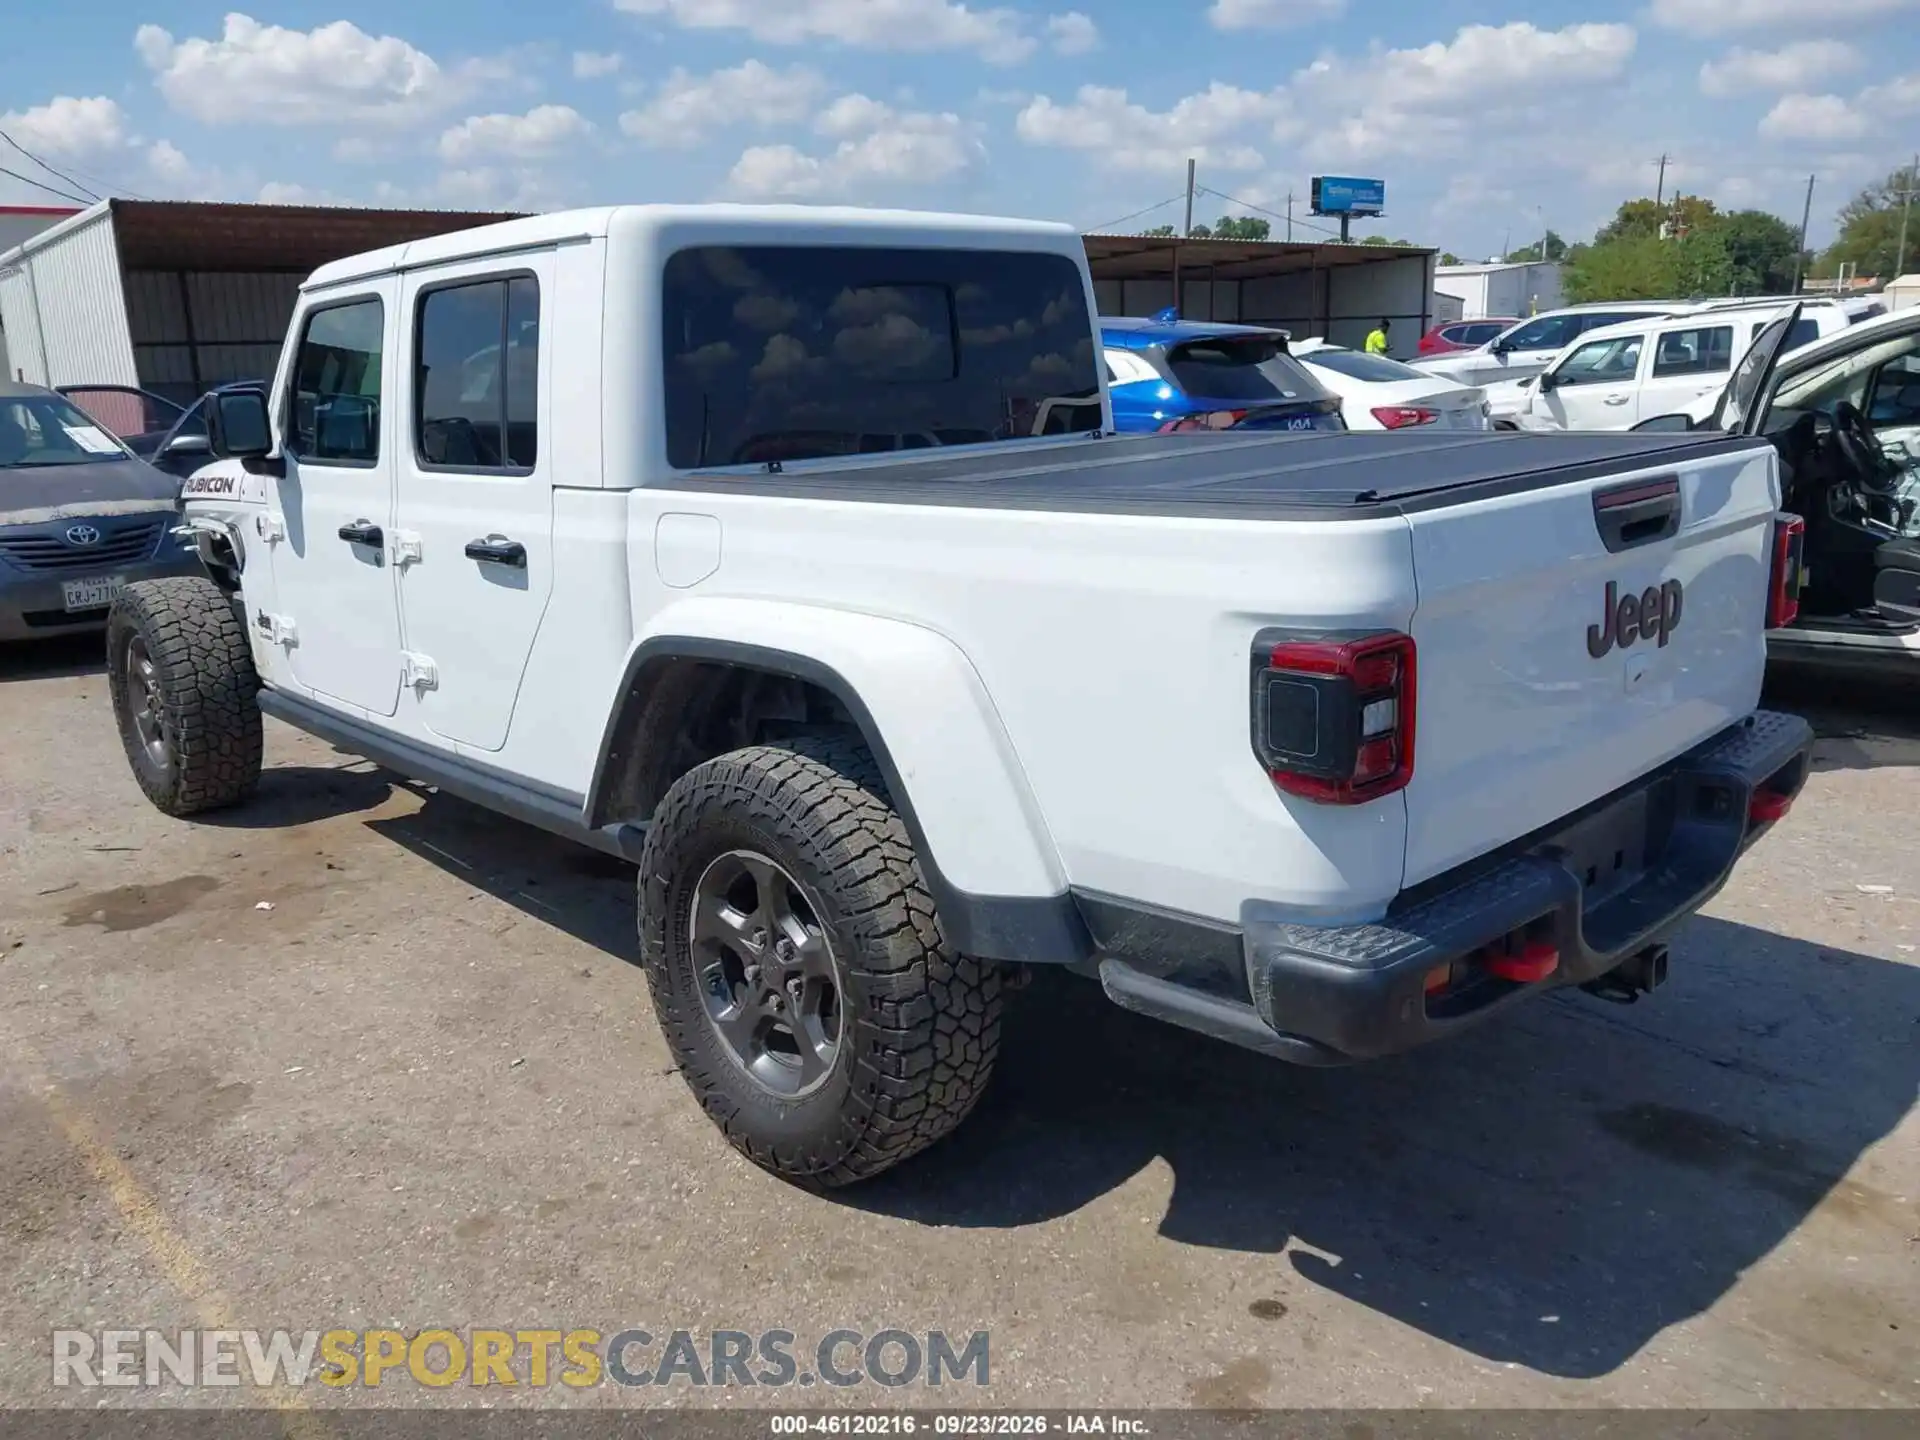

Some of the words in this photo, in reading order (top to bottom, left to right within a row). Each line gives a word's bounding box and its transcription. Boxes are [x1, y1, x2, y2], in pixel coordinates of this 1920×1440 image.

[184, 476, 235, 493] RUBICON
[67, 586, 121, 606] CRJ-770
[1587, 578, 1683, 659] Jeep
